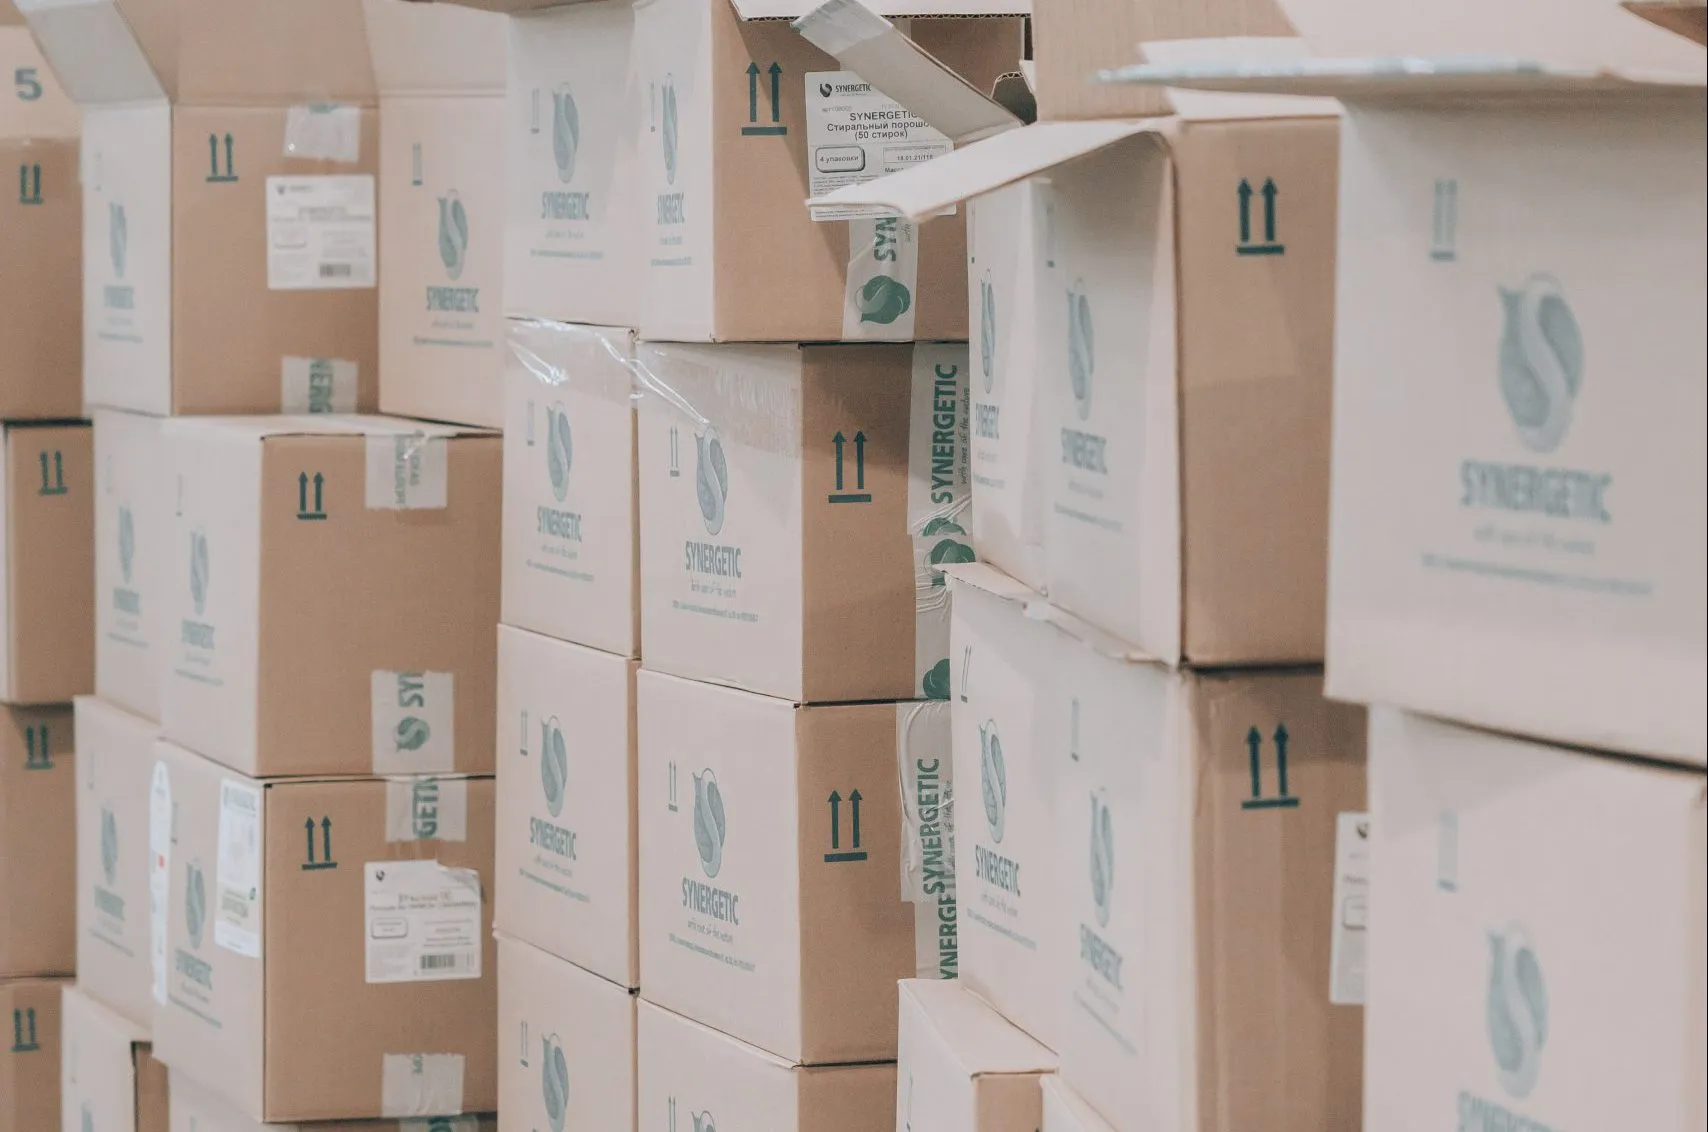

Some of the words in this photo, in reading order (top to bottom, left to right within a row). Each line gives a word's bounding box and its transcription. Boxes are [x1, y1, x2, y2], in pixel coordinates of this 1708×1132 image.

[14, 68, 43, 101] 5
[835, 84, 872, 93] SYNERGETIC
[827, 121, 889, 132] Стиральный
[891, 121, 931, 131] порошо
[855, 130, 869, 140] (50
[871, 127, 908, 140] стирок)
[931, 364, 958, 504] SYNERGETIC
[685, 540, 742, 579] SYNERGETIC
[529, 816, 577, 861] SYNERGETIC
[918, 758, 946, 897] SYNERGETIC
[974, 844, 1021, 897] SYNERGETIC
[682, 877, 740, 926] SYNERGETIC
